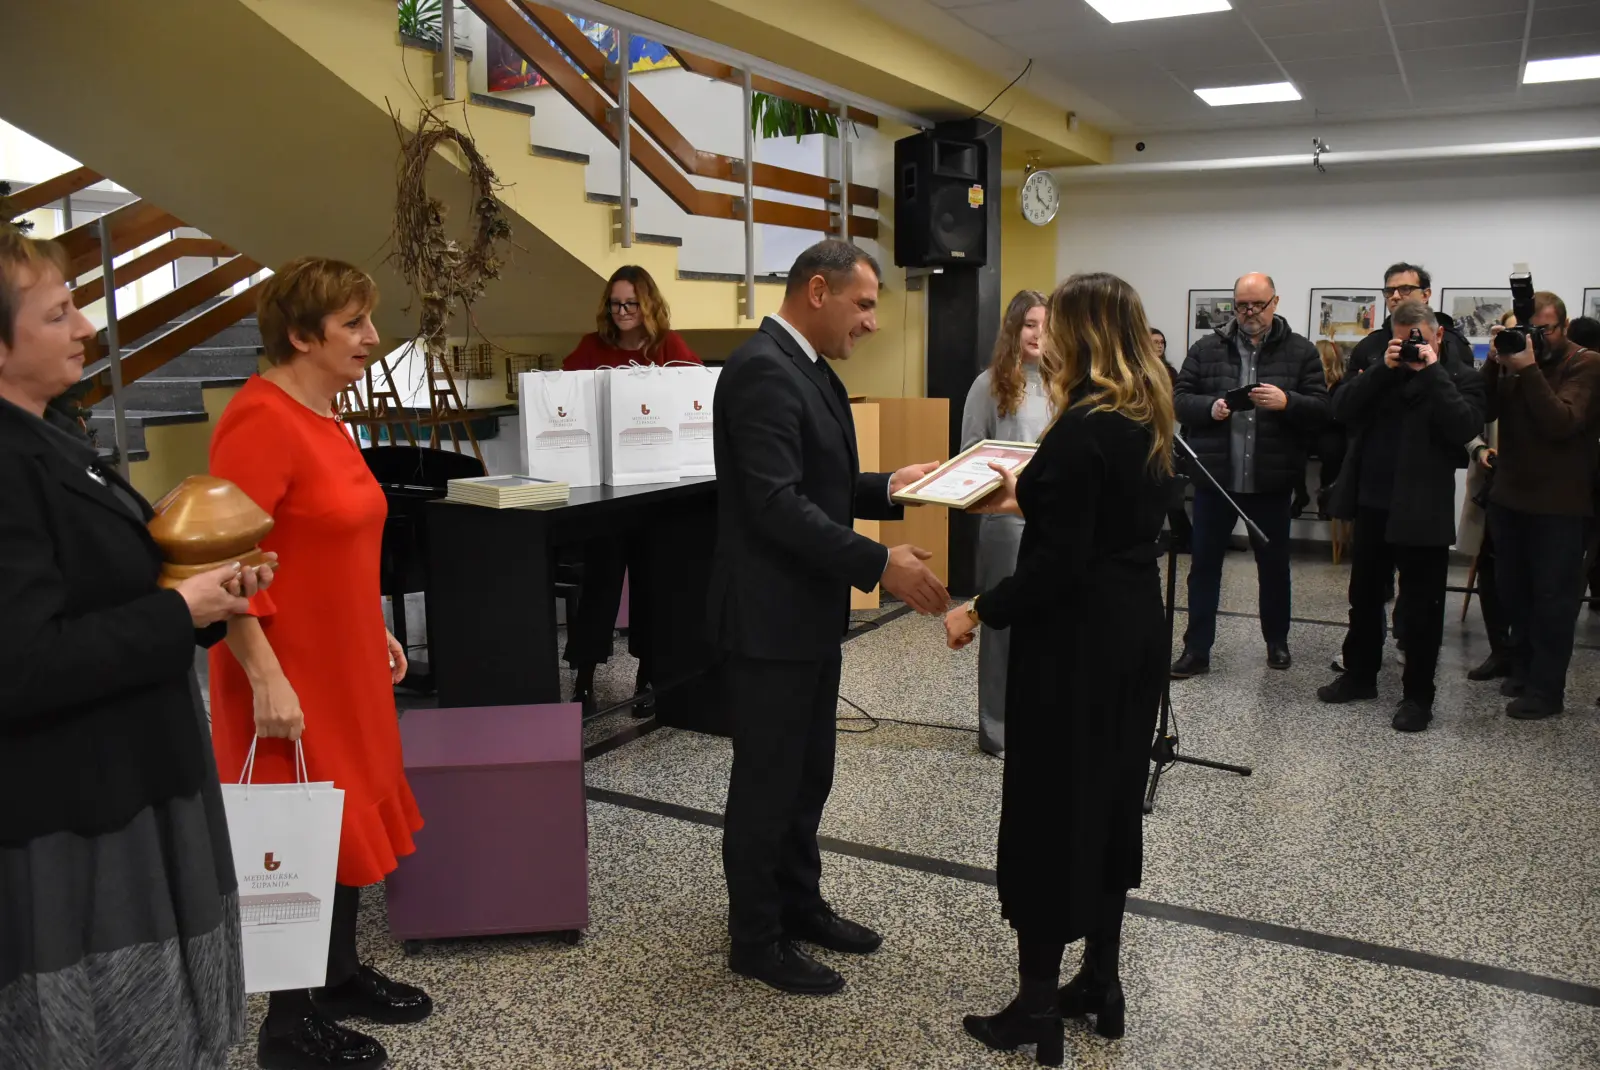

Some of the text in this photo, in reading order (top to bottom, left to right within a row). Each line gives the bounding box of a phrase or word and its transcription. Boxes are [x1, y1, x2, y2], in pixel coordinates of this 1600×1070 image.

[1036, 176, 1043, 184] 12
[1024, 193, 1029, 201] 9
[1034, 212, 1039, 220] 6
[243, 873, 299, 881] MEĐIMURSKA
[251, 881, 290, 889] ŽUPANIJA
